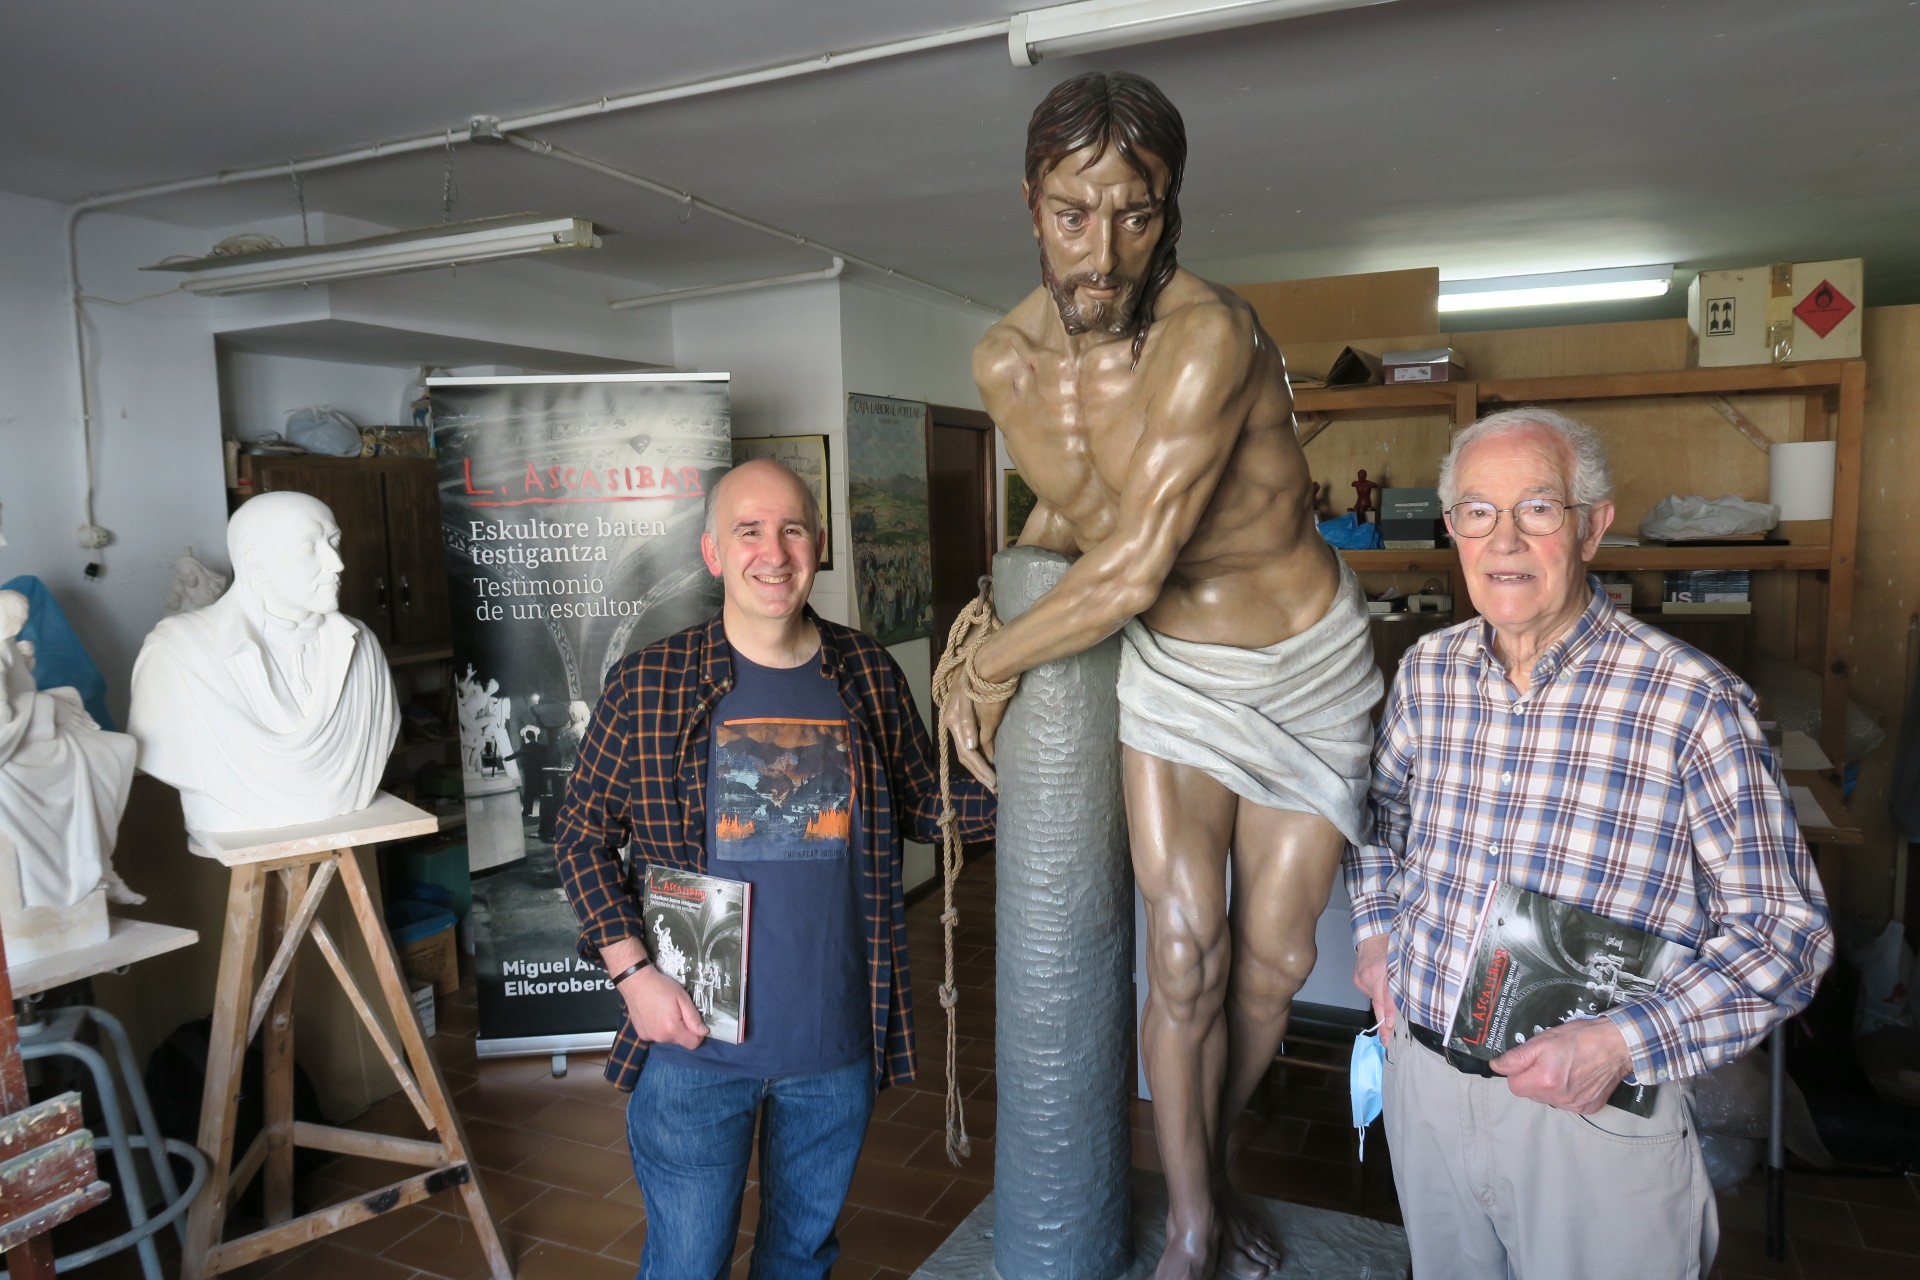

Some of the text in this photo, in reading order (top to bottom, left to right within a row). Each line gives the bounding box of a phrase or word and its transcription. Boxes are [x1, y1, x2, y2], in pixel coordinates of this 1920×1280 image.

[463, 456, 702, 496] L. ASCASIBAR
[469, 517, 667, 541] Eskultore baten
[471, 543, 608, 568] testigantza
[473, 574, 604, 598] Testimonio
[476, 597, 642, 621] de un escultor
[502, 957, 571, 977] Miguel
[1472, 948, 1507, 1021] ASCASIBAR
[1486, 960, 1518, 1049] Eskultore baten testigantza
